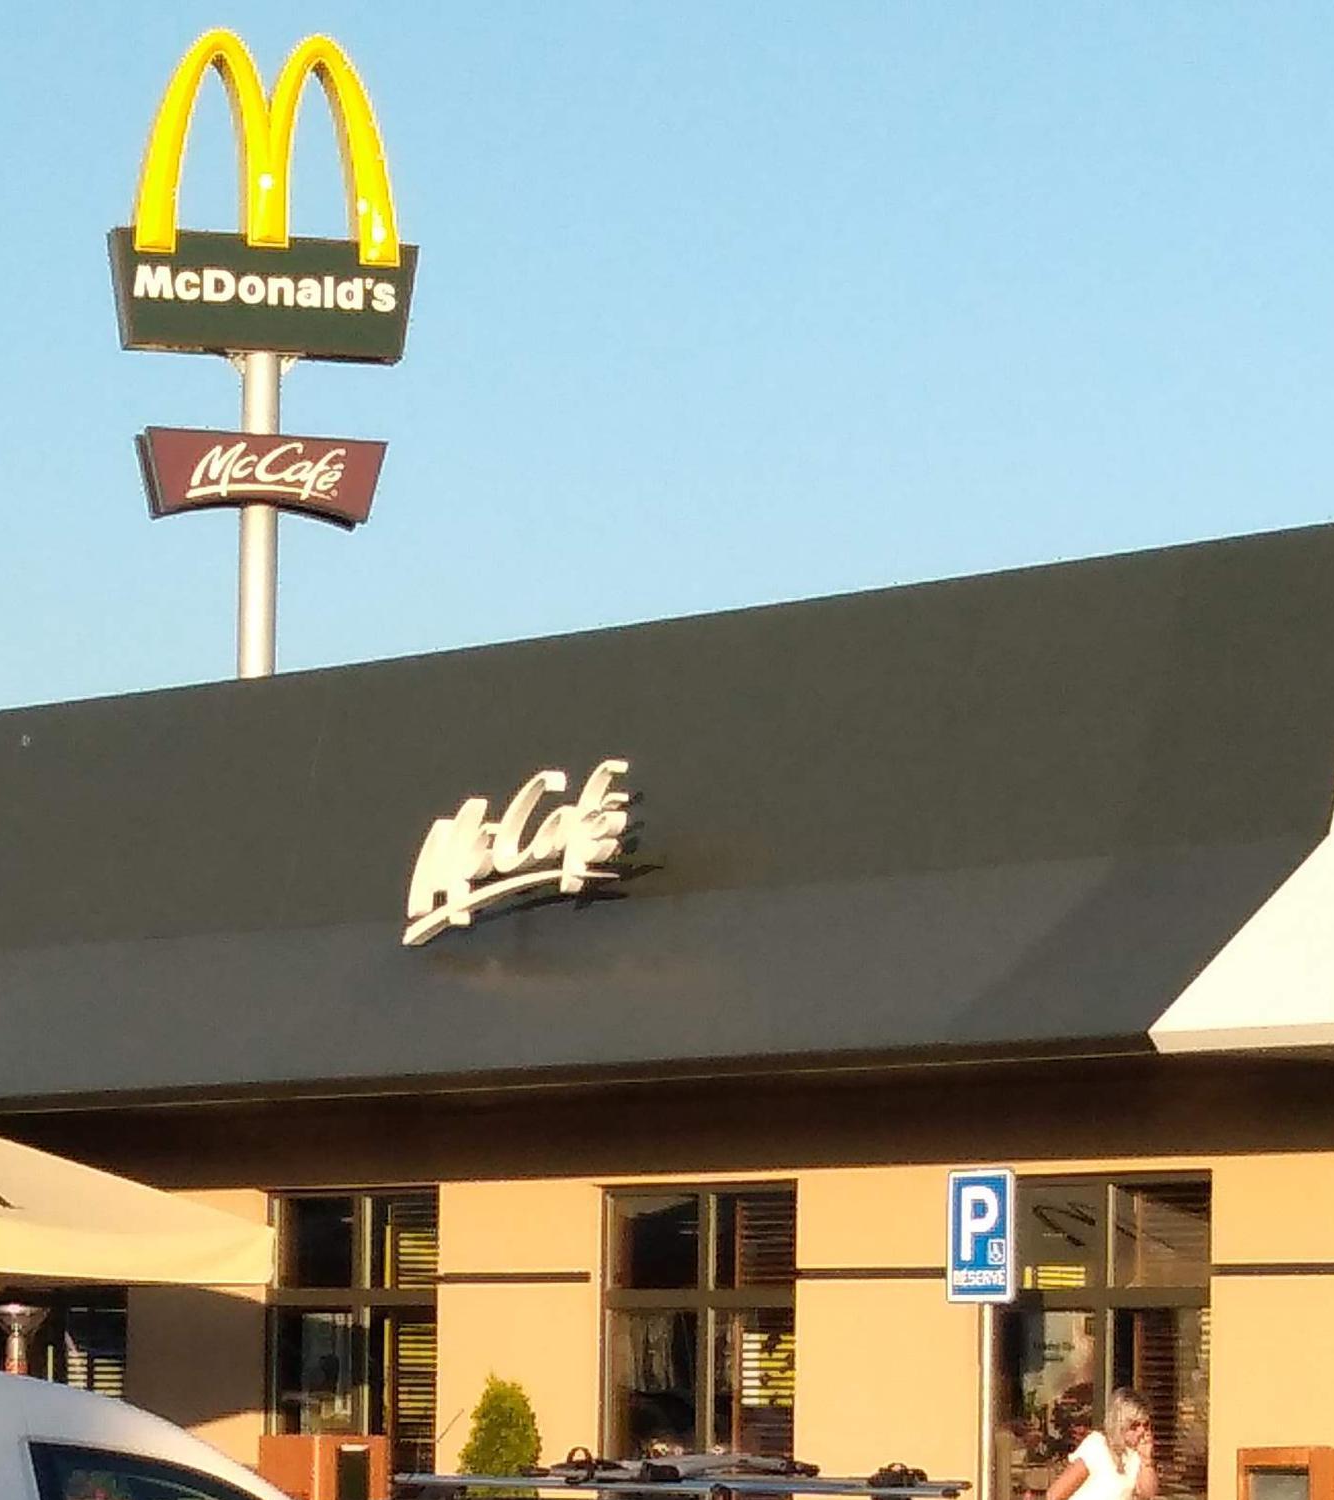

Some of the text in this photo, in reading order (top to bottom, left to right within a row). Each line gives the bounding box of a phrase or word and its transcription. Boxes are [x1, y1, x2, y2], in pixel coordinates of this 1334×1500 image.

[133, 264, 397, 314] McDonald's
[186, 441, 346, 500] McCafé
[960, 1185, 999, 1262] P
